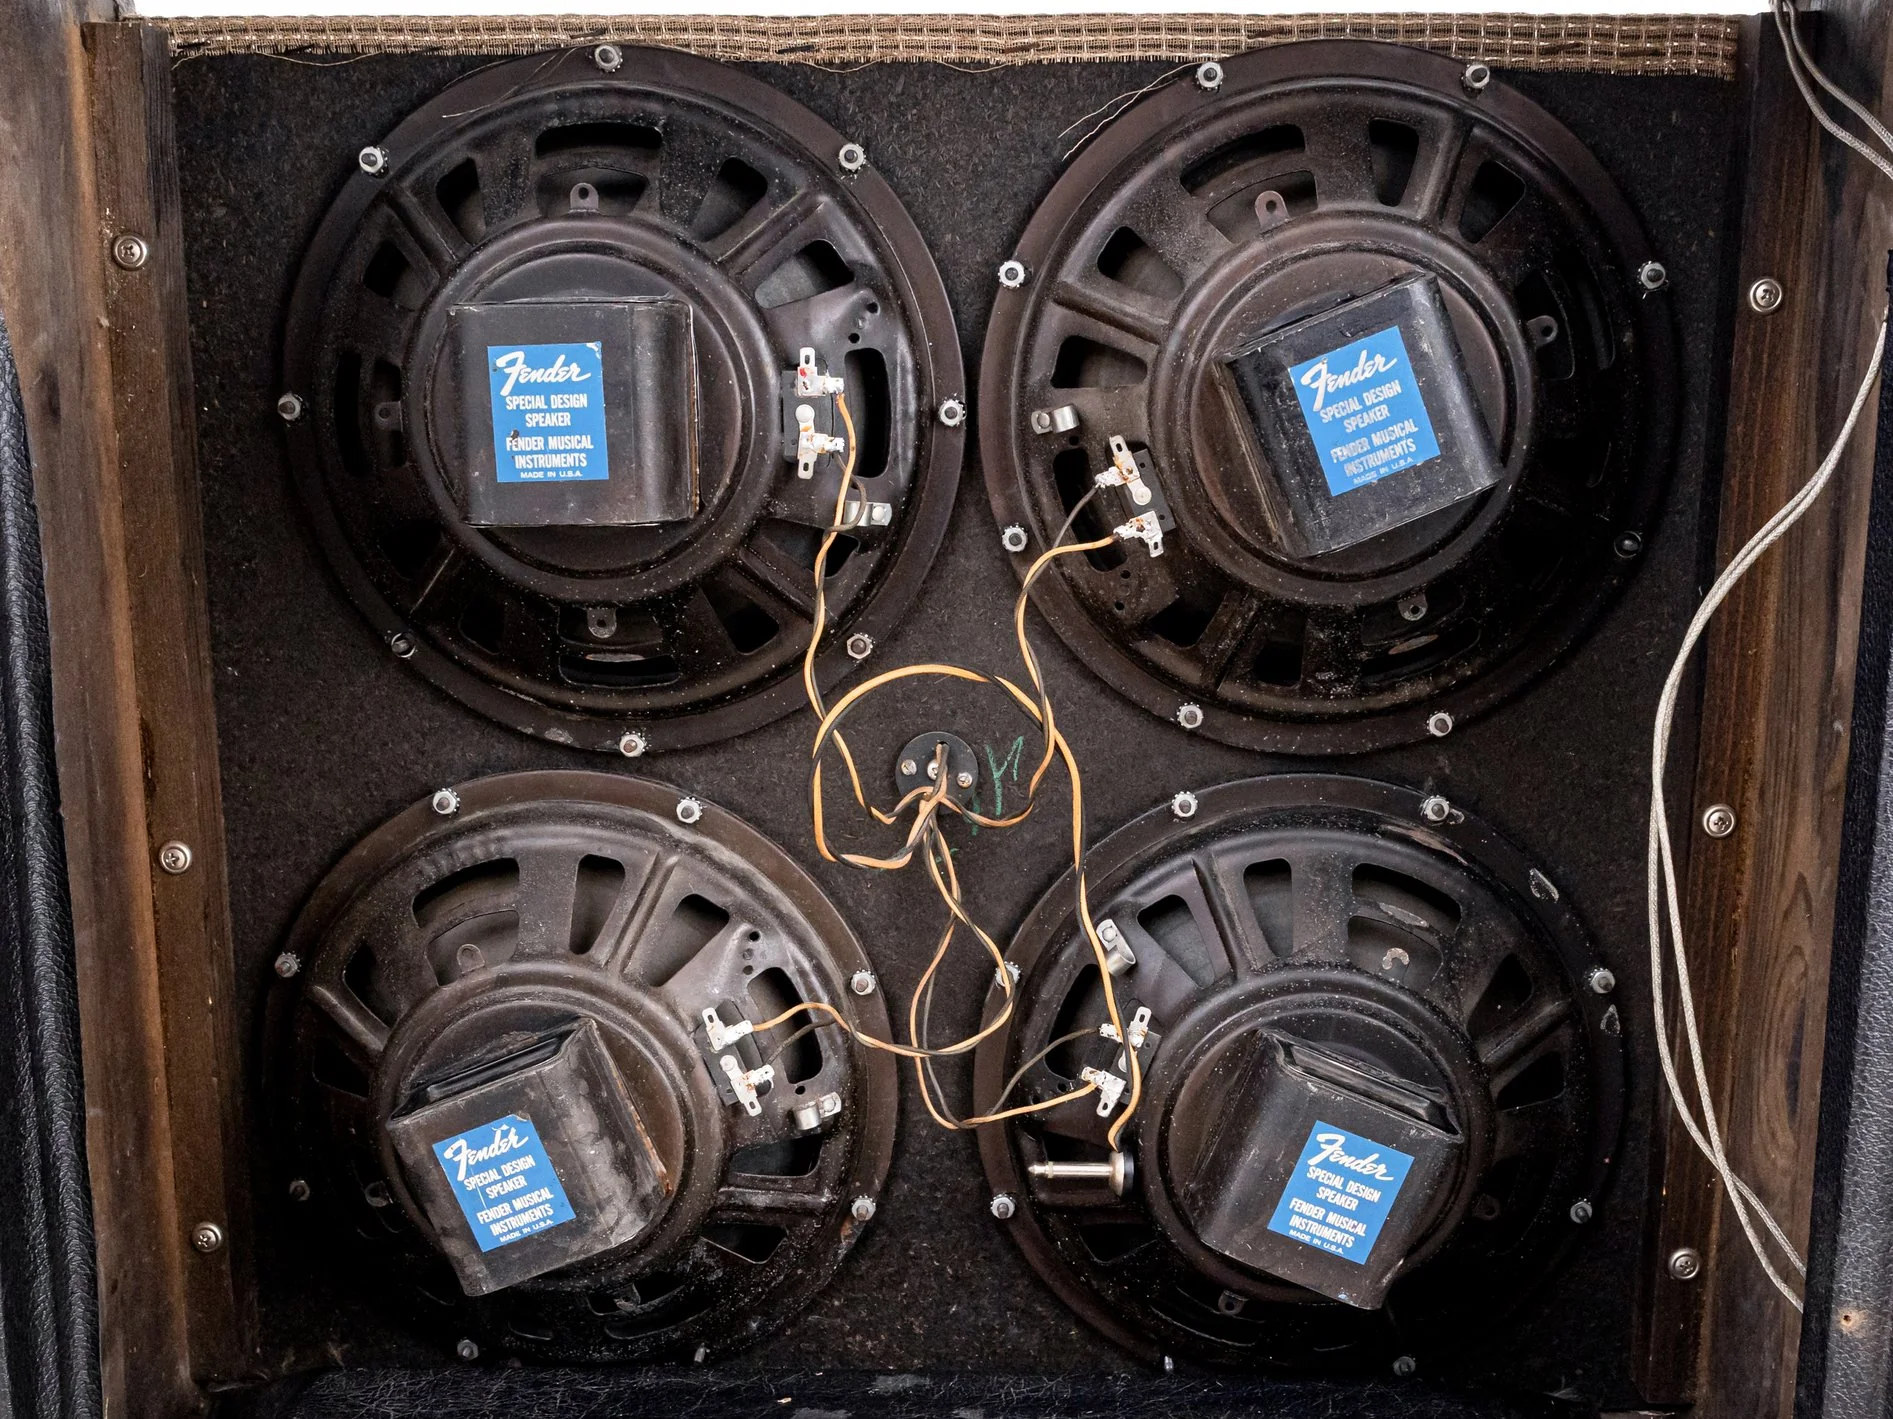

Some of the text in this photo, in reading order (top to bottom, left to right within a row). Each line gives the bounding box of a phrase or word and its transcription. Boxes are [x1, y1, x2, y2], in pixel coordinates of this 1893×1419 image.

[495, 351, 592, 396] Fender
[1300, 349, 1398, 412] Fender
[505, 393, 588, 410] SPECIAL DESIGN
[1319, 379, 1402, 423] SPECIAL DESIGN
[525, 412, 571, 428] SPEAKER
[1343, 404, 1390, 433] SPEAKER
[505, 435, 594, 451] FENDER MUSICAL
[1330, 418, 1419, 463] FENDER MUSICAL
[514, 453, 588, 469] INSTRUMENTS
[1343, 438, 1416, 477] INSTRUMENTS
[1379, 466, 1389, 474] IN
[520, 471, 545, 479] MADE
[443, 1124, 529, 1181] Fender
[1307, 1133, 1394, 1180] Fender
[463, 1154, 536, 1191] SPECIAL DESIGN
[485, 1174, 528, 1199] SPEAKER
[1306, 1166, 1381, 1203] SPECIAL DESIGN
[476, 1187, 554, 1224] FENDER MUSICAL
[1316, 1186, 1359, 1211] SPEAKER
[489, 1203, 554, 1236] INSTRUMENTS
[1289, 1197, 1367, 1237] FENDER MUSICAL
[1289, 1214, 1355, 1248] INSTRUMENTS
[499, 1231, 521, 1243] MADE
[522, 1227, 532, 1235] IN
[1289, 1229, 1312, 1243] MADE
[1313, 1238, 1322, 1246] IN
